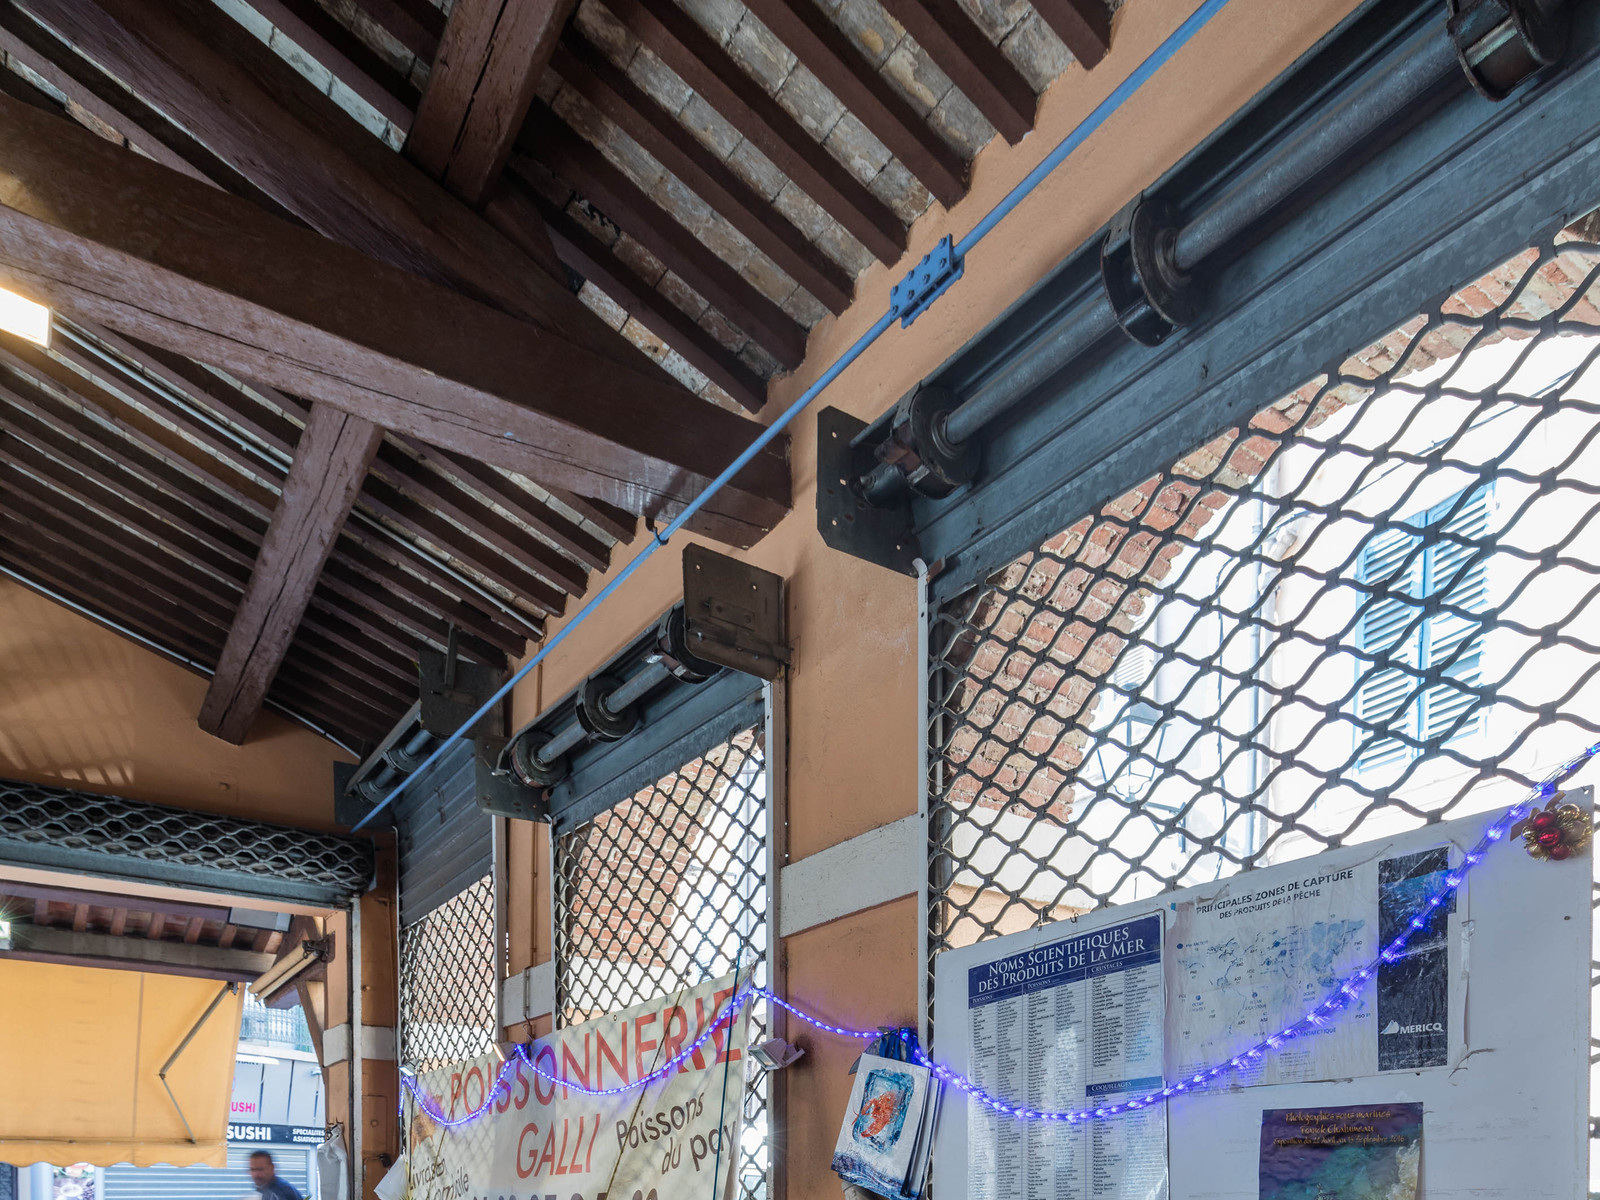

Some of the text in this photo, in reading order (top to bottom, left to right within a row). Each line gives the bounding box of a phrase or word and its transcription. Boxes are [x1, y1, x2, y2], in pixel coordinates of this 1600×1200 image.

[1196, 870, 1353, 915] PRINCIPALES ZONES DE CAPTURE
[1219, 911, 1232, 920] DES
[1234, 900, 1271, 917] PRODUITS
[1293, 889, 1321, 901] PÊCHE
[978, 977, 998, 993] DES
[1002, 959, 1065, 986] PRODUITS
[1068, 953, 1086, 969] DE
[1090, 948, 1107, 962] LA
[1111, 938, 1146, 958] MER
[989, 926, 1129, 977] NOMS SCIENTIFIQUES
[1400, 1022, 1444, 1034] MERICQ
[451, 984, 742, 1122] POISSONNERIE
[230, 1101, 256, 1113] USHI
[616, 1092, 705, 1150] Poissons
[1356, 1110, 1391, 1120] marines
[226, 1125, 272, 1141] SUSHI
[516, 1113, 601, 1179] GALLI
[662, 1121, 737, 1175] du pay
